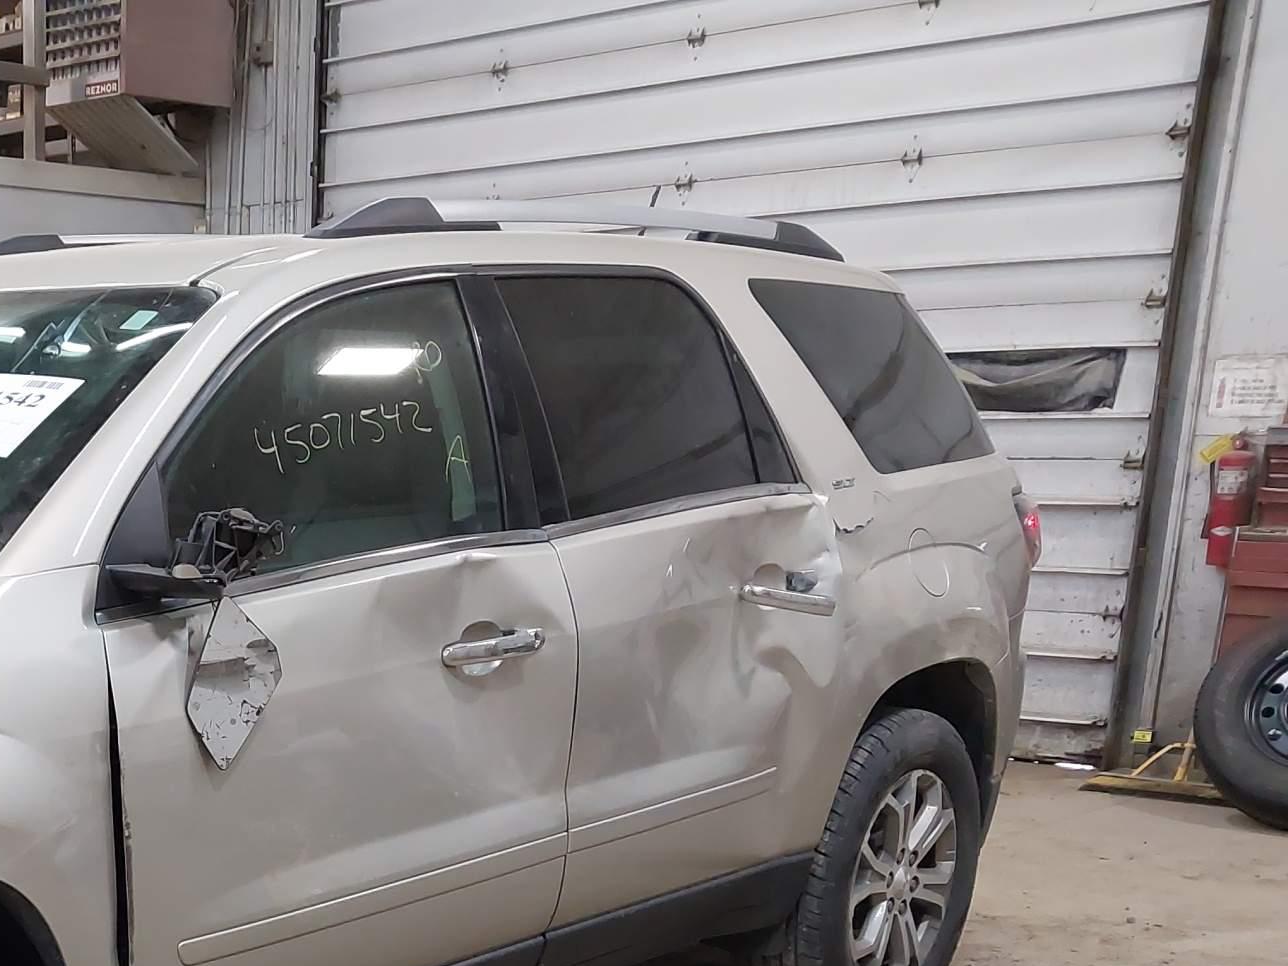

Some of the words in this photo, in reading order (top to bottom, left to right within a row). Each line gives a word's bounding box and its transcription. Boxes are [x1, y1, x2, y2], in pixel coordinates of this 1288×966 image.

[85, 82, 117, 96] REZNOR
[253, 400, 433, 474] 45071542
[445, 434, 471, 482] A
